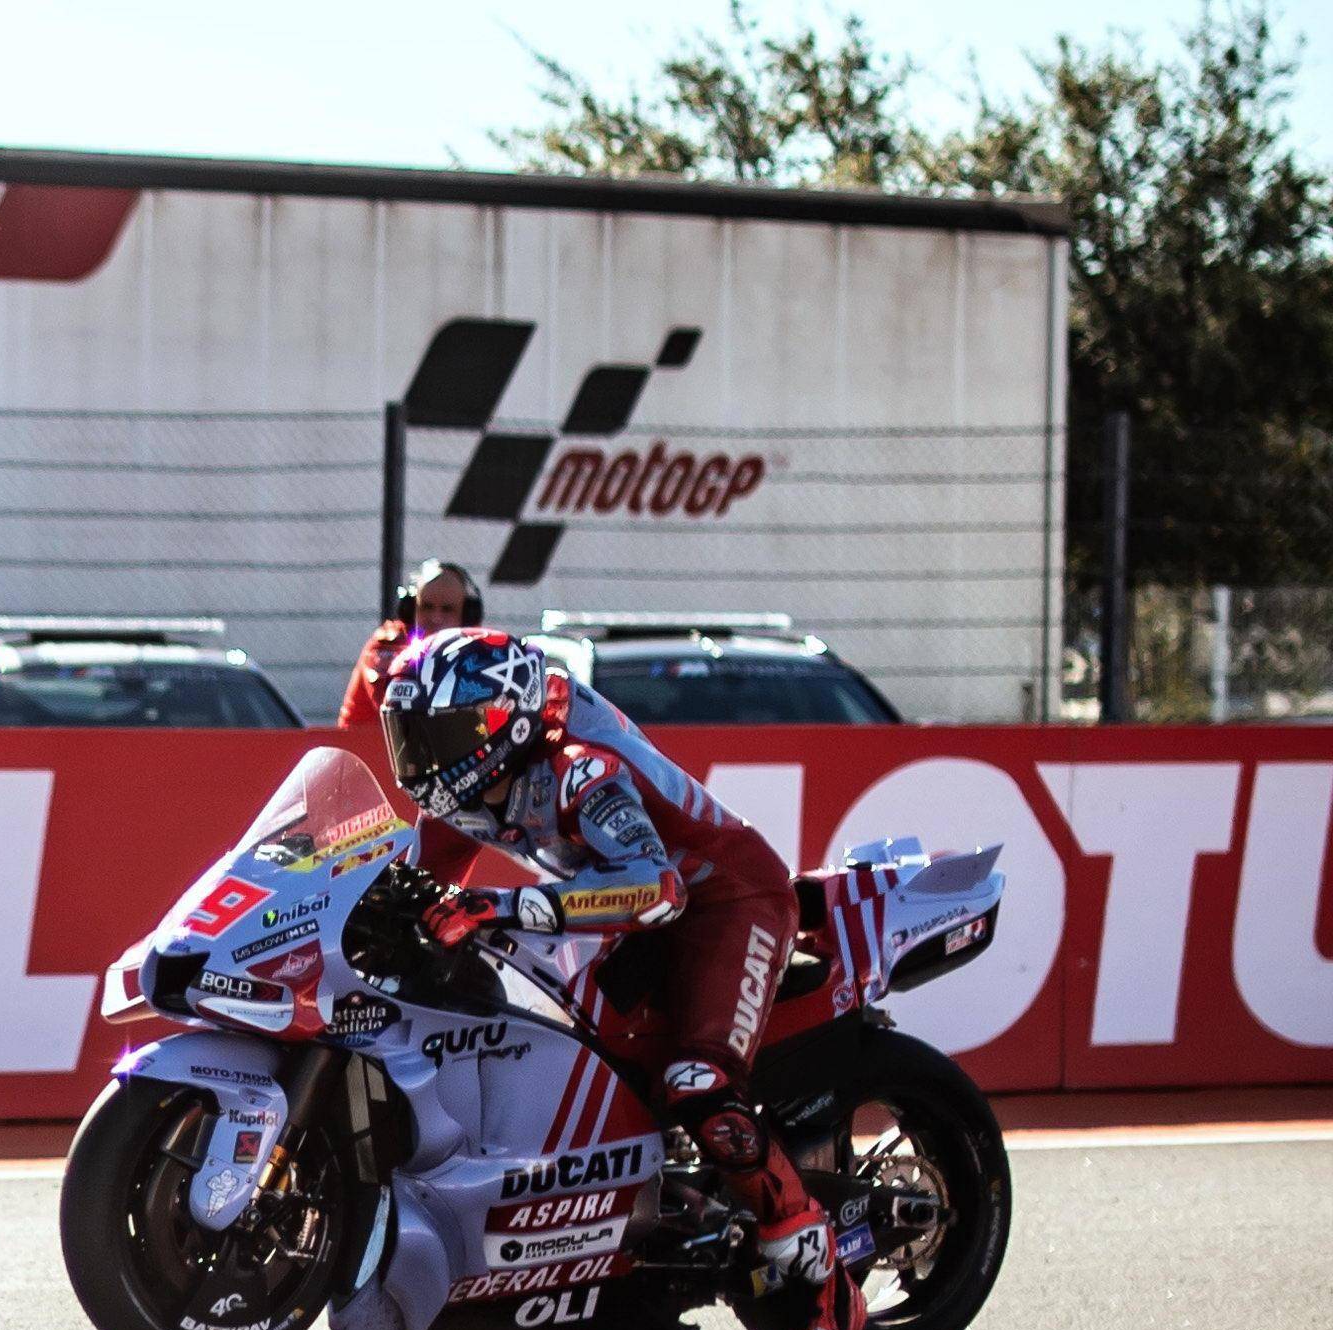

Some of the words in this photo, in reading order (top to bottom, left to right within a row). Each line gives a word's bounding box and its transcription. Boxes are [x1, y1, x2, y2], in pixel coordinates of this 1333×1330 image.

[261, 893, 331, 929] Unibat
[201, 970, 252, 994] BOLD
[727, 923, 776, 1057] DUCATI
[334, 1006, 387, 1021] strella
[500, 1144, 643, 1200] DUCATI
[508, 1190, 617, 1228] ASPIRA
[526, 1227, 613, 1252] MODULA
[449, 1264, 563, 1303] EDERAL
[568, 1255, 616, 1283] OIL
[515, 1286, 601, 1329] OLI
